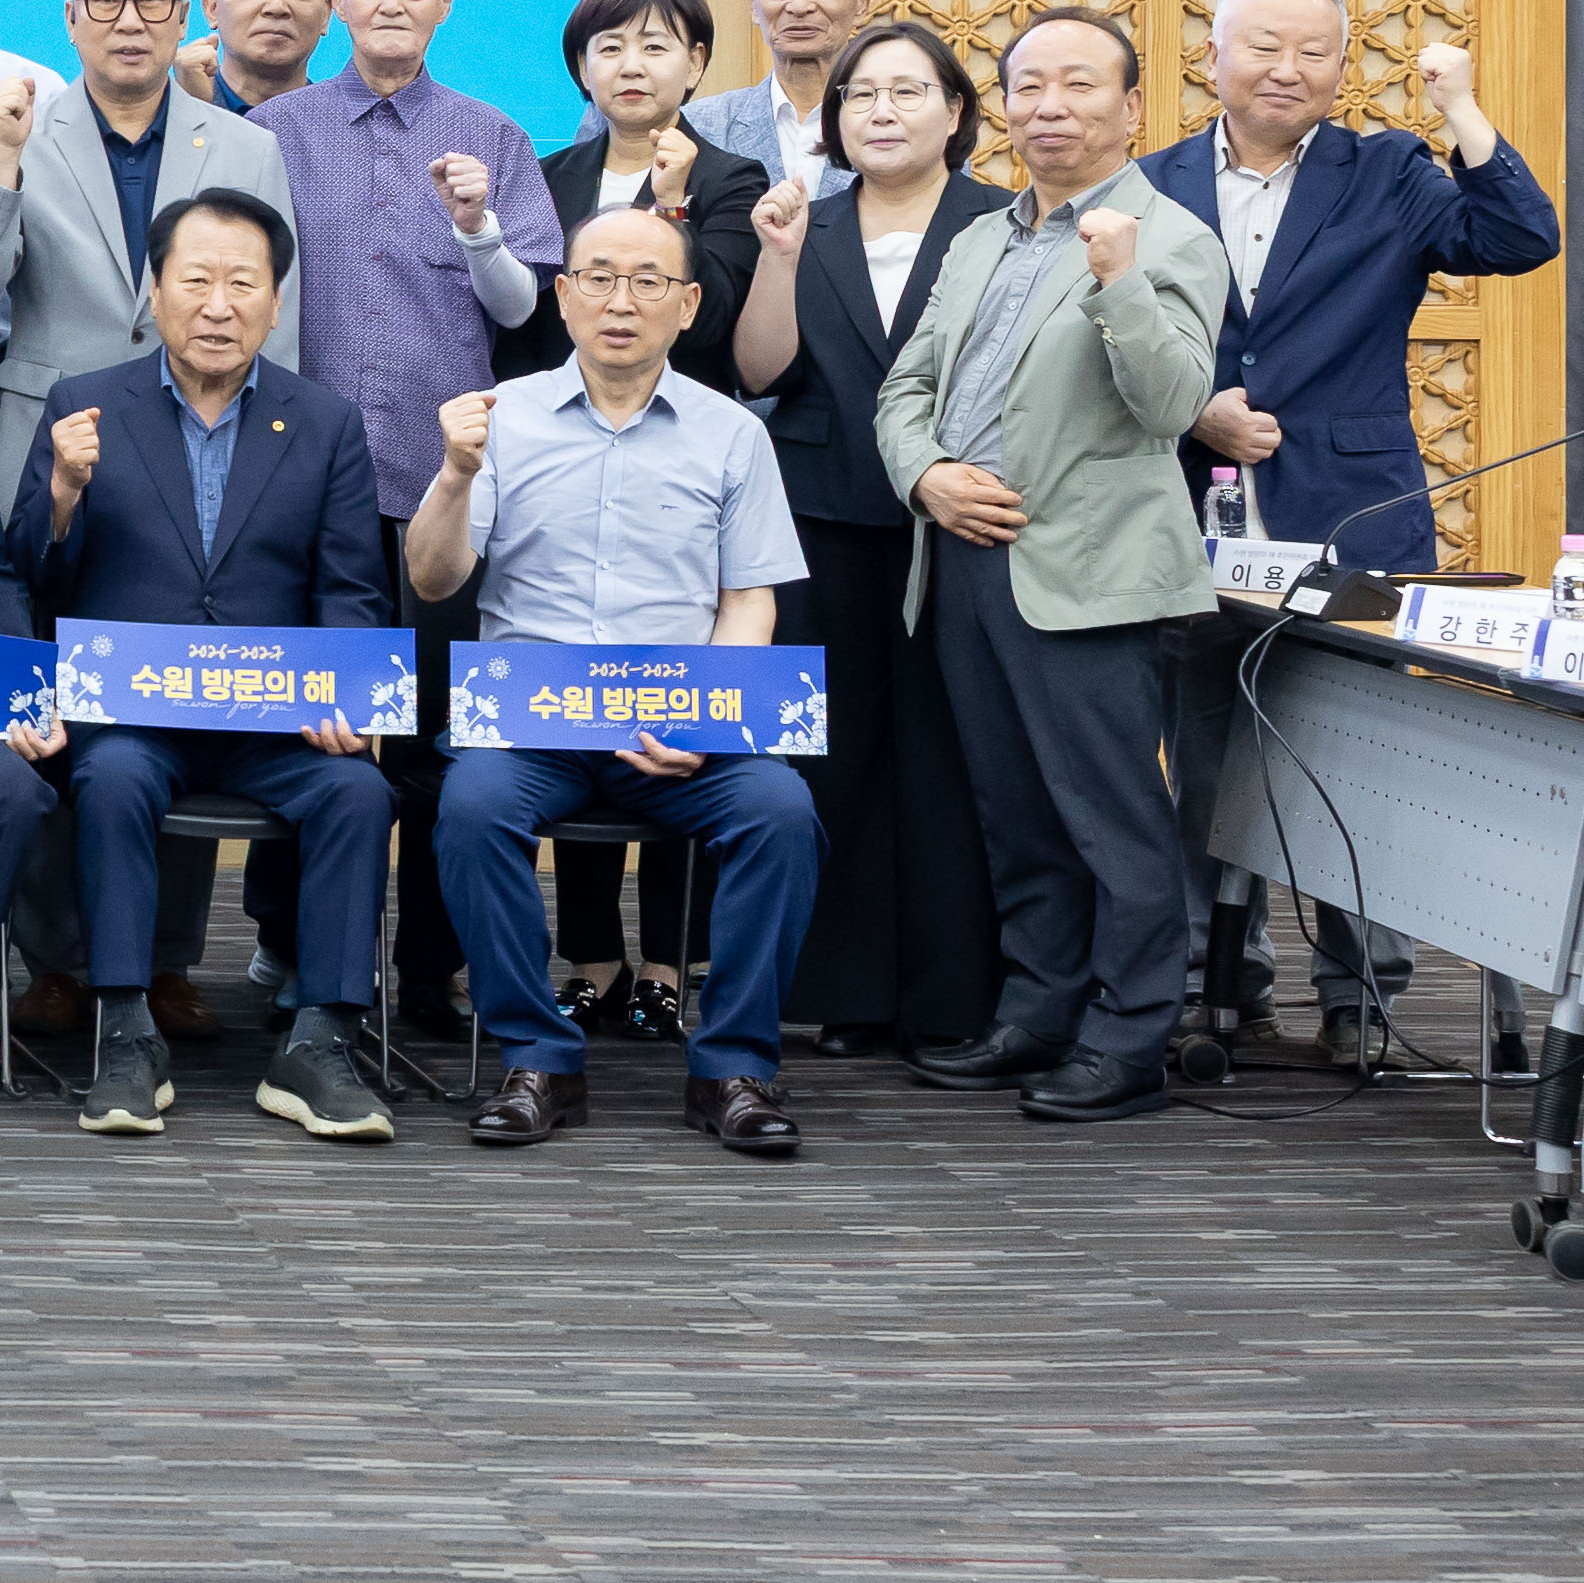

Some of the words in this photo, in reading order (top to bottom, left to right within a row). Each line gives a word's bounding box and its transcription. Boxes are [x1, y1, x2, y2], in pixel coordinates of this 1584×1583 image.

[131, 664, 193, 699] 수원
[201, 668, 295, 703] 방문의
[303, 670, 336, 704] 해
[529, 685, 594, 720] 수원
[603, 687, 700, 721] 방문의
[708, 688, 742, 722] 해
